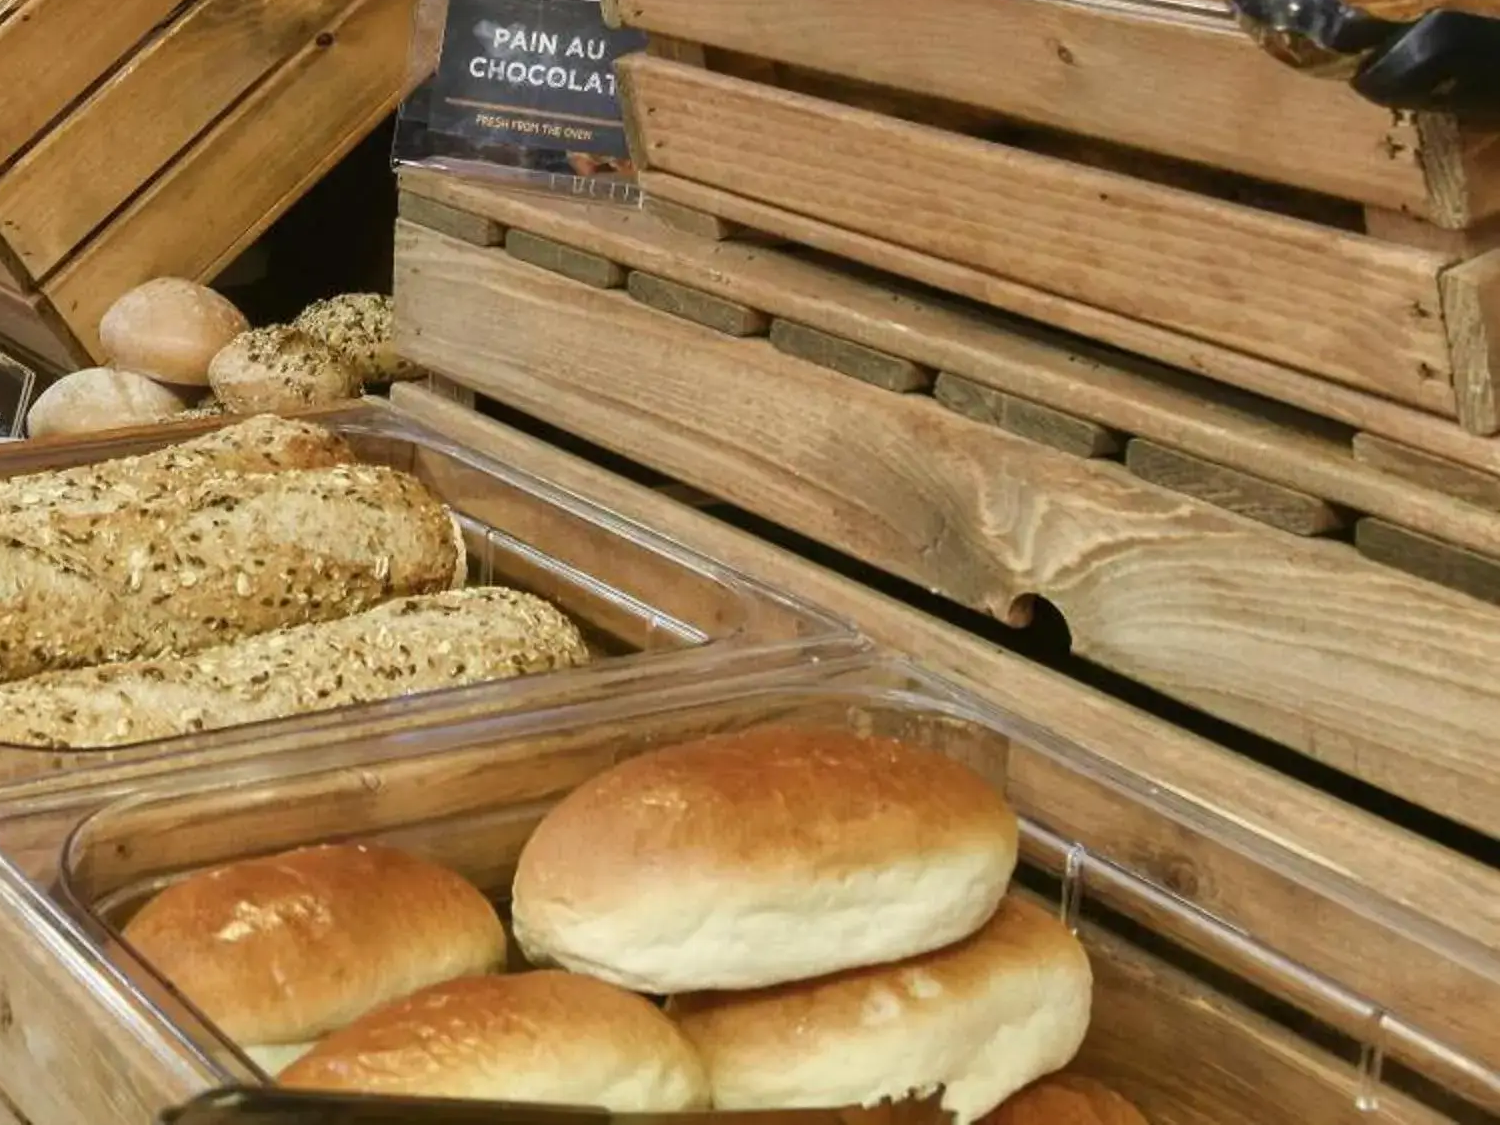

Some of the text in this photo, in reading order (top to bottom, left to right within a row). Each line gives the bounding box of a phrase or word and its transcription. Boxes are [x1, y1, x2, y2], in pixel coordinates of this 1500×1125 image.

[493, 28, 606, 60] PAIN AU
[469, 56, 616, 96] CHOCOLAT
[476, 114, 593, 140] FRESH FROM THE OVEN
